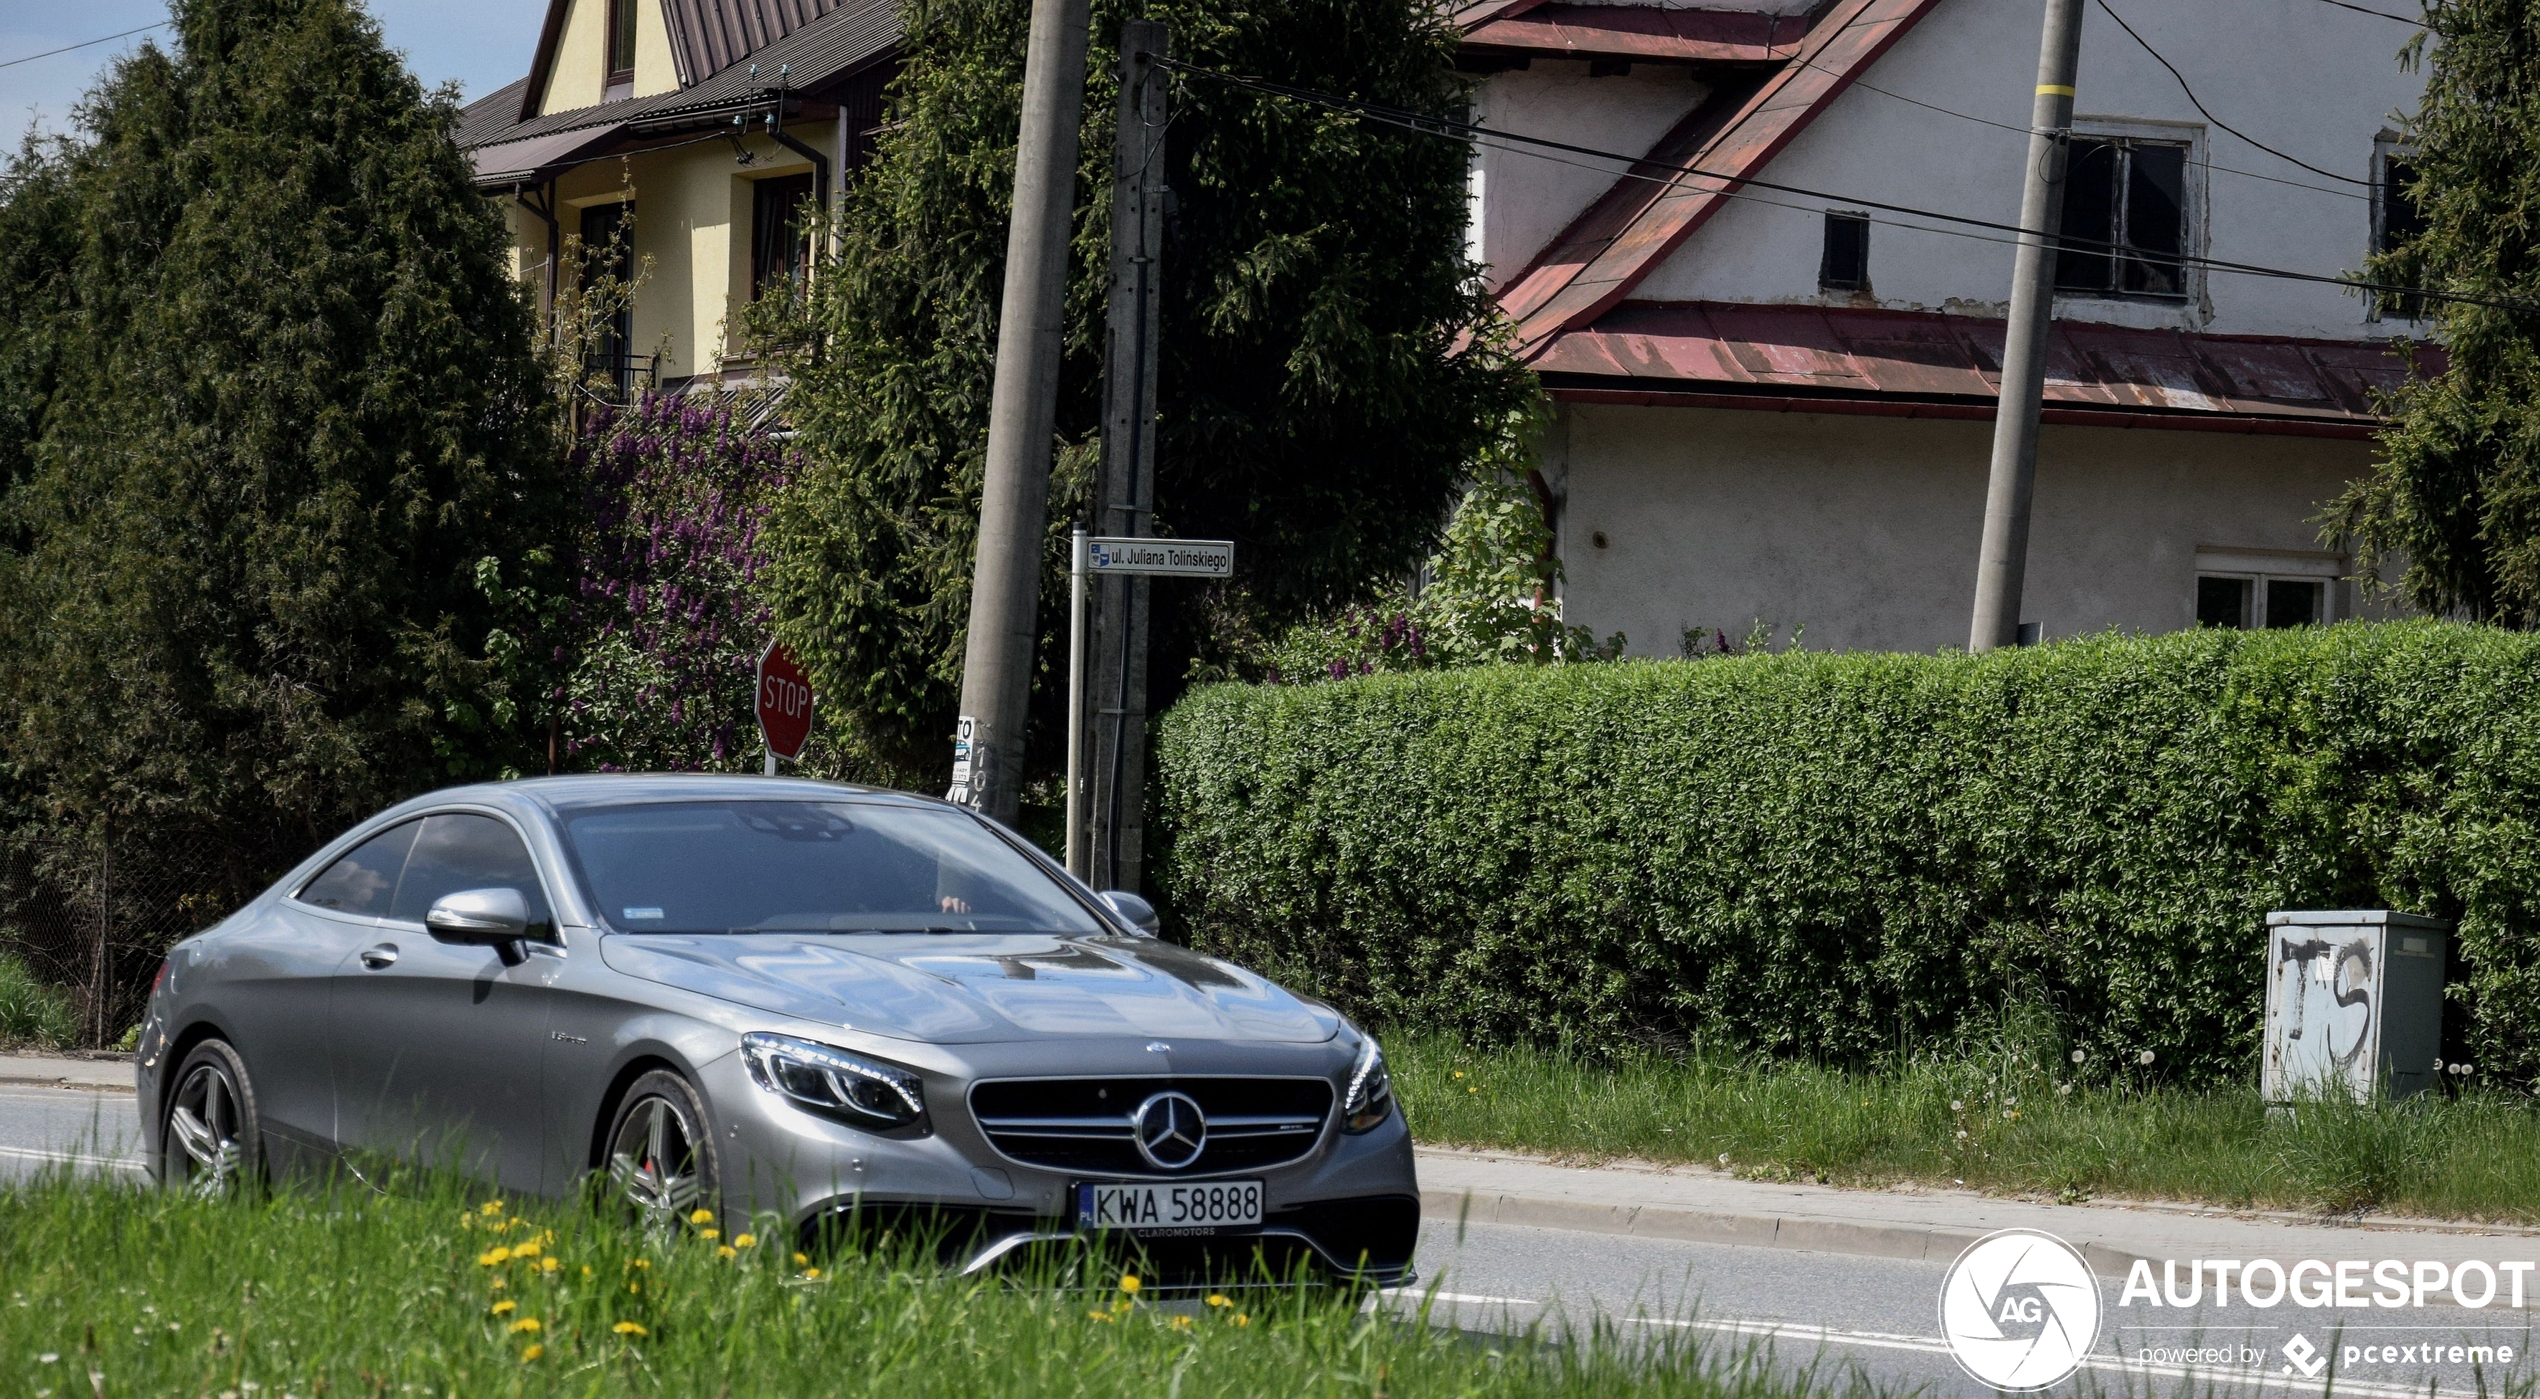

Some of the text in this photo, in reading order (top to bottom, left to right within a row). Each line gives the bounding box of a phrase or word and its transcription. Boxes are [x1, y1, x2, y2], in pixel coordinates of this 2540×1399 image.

[1112, 548, 1226, 571] ul. Juliana Tolińskiego
[765, 675, 808, 719] STOP
[1080, 1211, 1093, 1222] PL
[1097, 1186, 1258, 1224] KWA 58888
[1138, 1227, 1215, 1238] CLAROMOTORS
